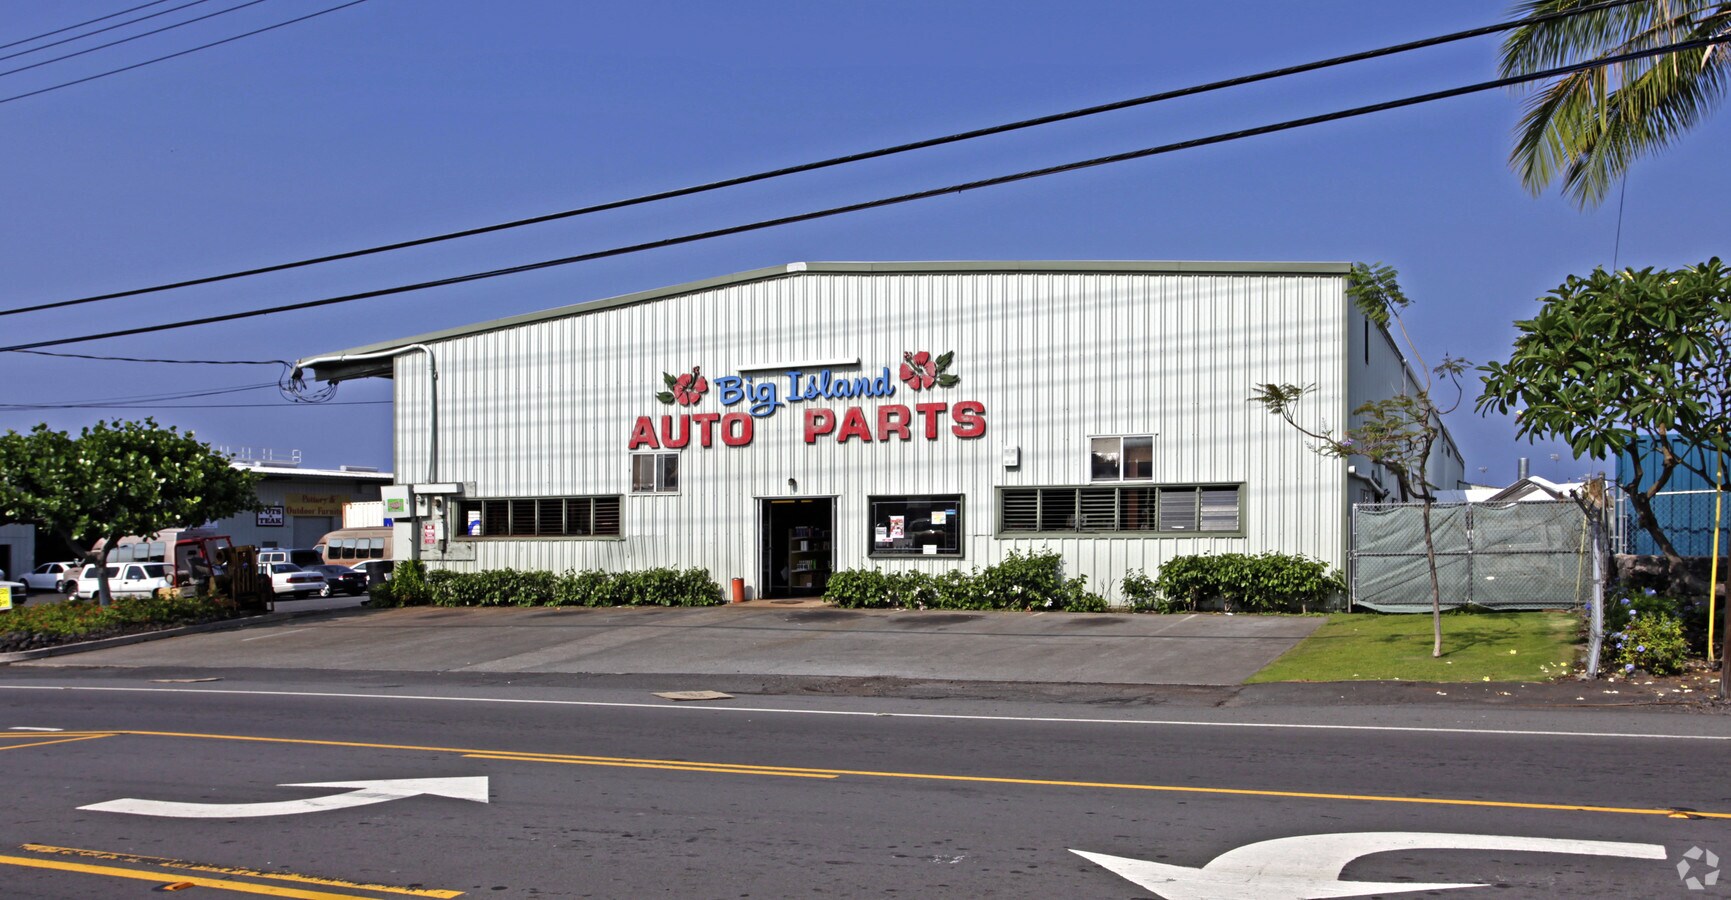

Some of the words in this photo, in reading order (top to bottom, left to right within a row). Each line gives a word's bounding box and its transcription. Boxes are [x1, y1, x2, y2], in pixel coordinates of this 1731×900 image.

[714, 375, 784, 416] Big
[785, 367, 896, 401] Island
[628, 412, 754, 449] AUTO
[804, 401, 986, 444] PARTS
[286, 506, 315, 514] Outdoor
